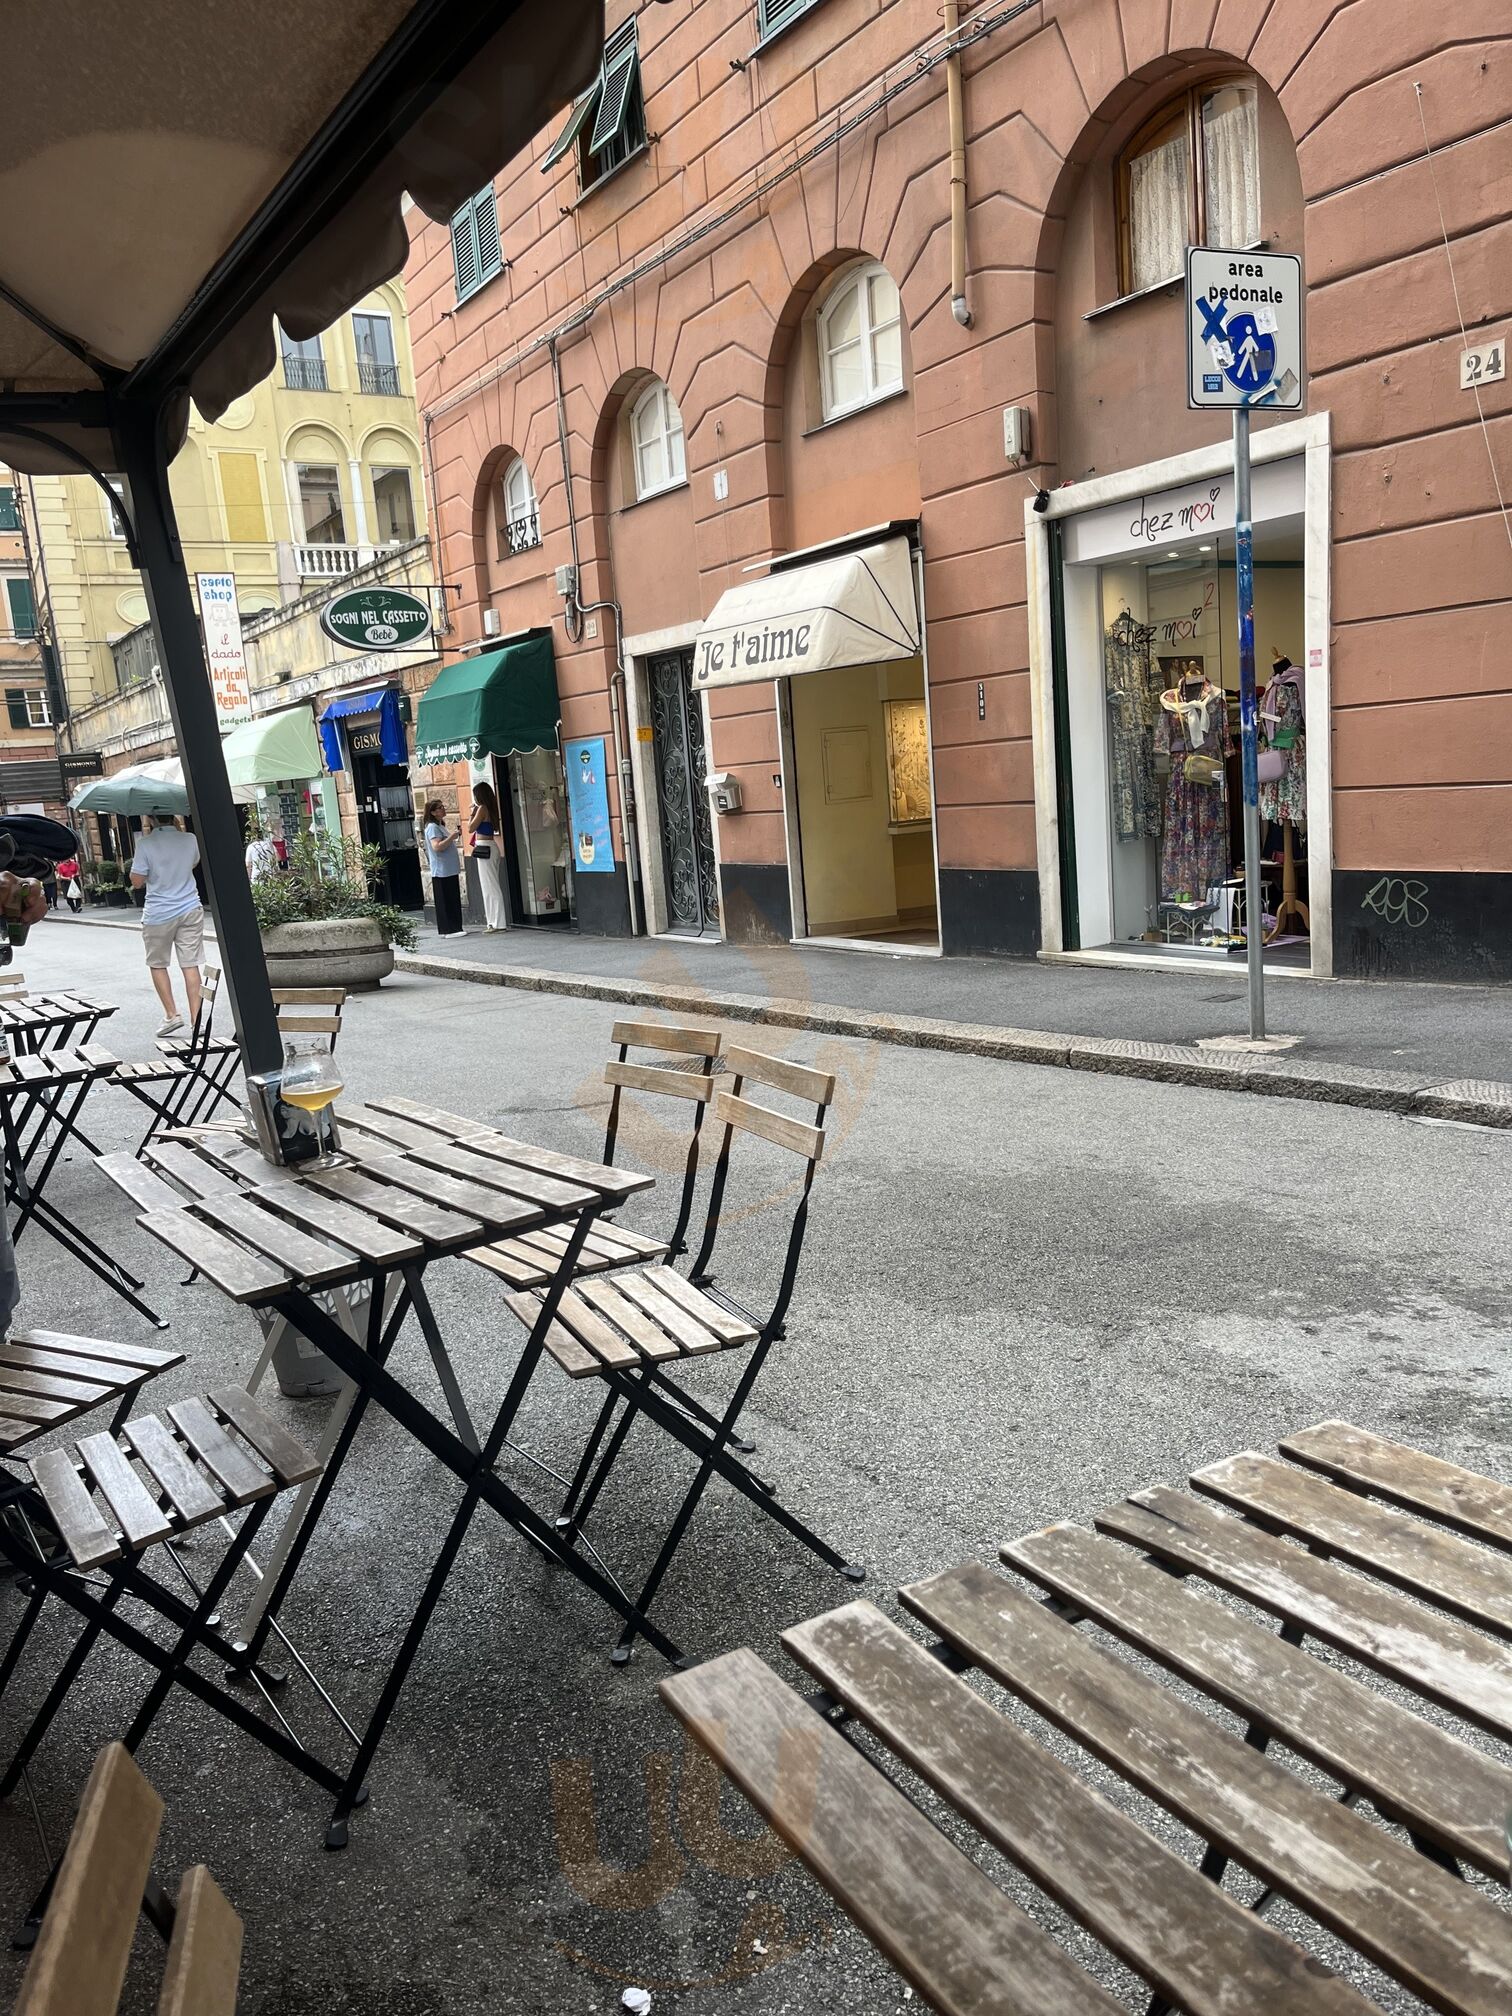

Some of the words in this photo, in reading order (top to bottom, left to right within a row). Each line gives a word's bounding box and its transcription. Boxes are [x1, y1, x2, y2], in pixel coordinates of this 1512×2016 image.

[1228, 262, 1263, 278] area
[1209, 284, 1283, 303] pedonale
[1466, 348, 1501, 381] 24
[1130, 497, 1173, 541] chez
[204, 589, 233, 602] shop
[330, 611, 359, 625] SOGNI
[361, 610, 380, 625] NEL
[382, 610, 427, 625] CASSETTO
[370, 628, 393, 640] Bebè
[1118, 607, 1157, 652] chez
[221, 634, 230, 645] il
[211, 649, 241, 659] dado
[698, 640, 724, 680] Je
[730, 625, 811, 668] t'aime
[226, 682, 239, 693] da
[217, 692, 248, 709] Regalo
[219, 716, 251, 726] gadgets
